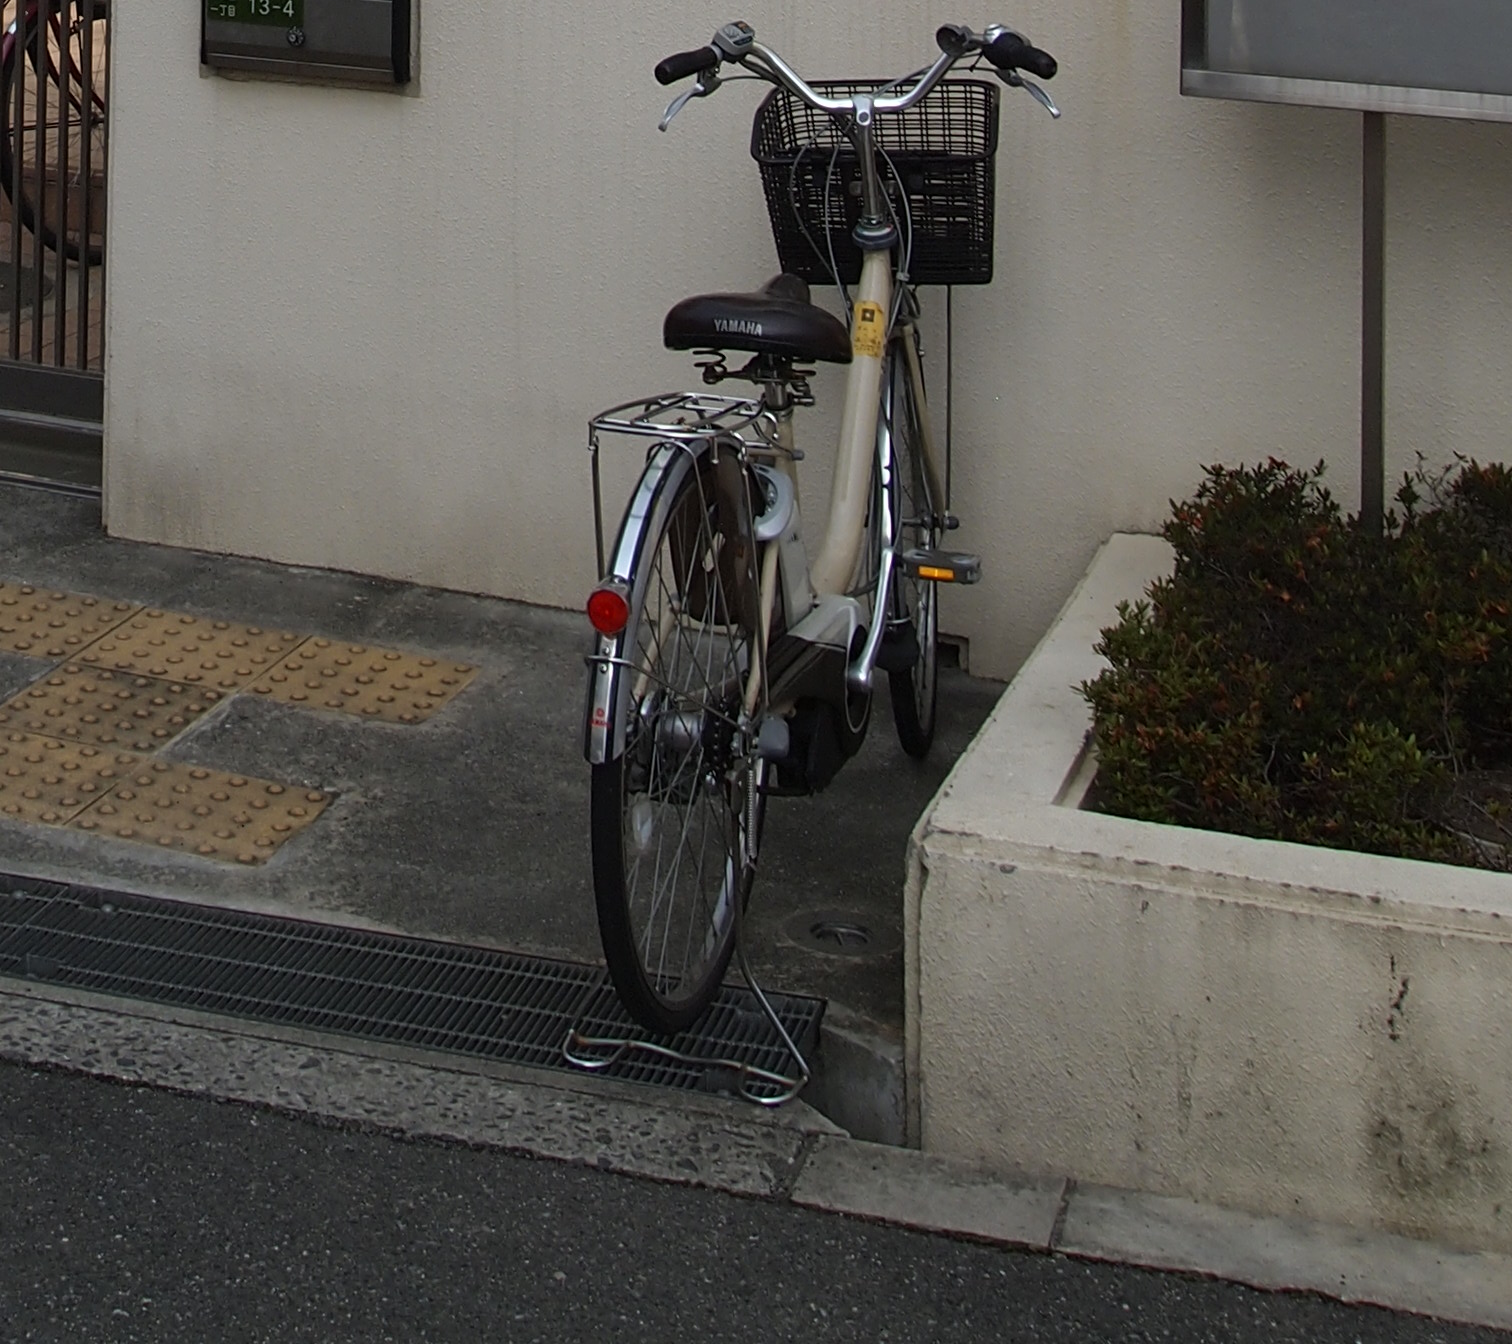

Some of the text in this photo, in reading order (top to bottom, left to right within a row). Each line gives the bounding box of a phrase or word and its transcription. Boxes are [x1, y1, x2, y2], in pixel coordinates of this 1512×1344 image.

[210, 4, 236, 18] 一丁目
[714, 318, 763, 337] YAMAHA
